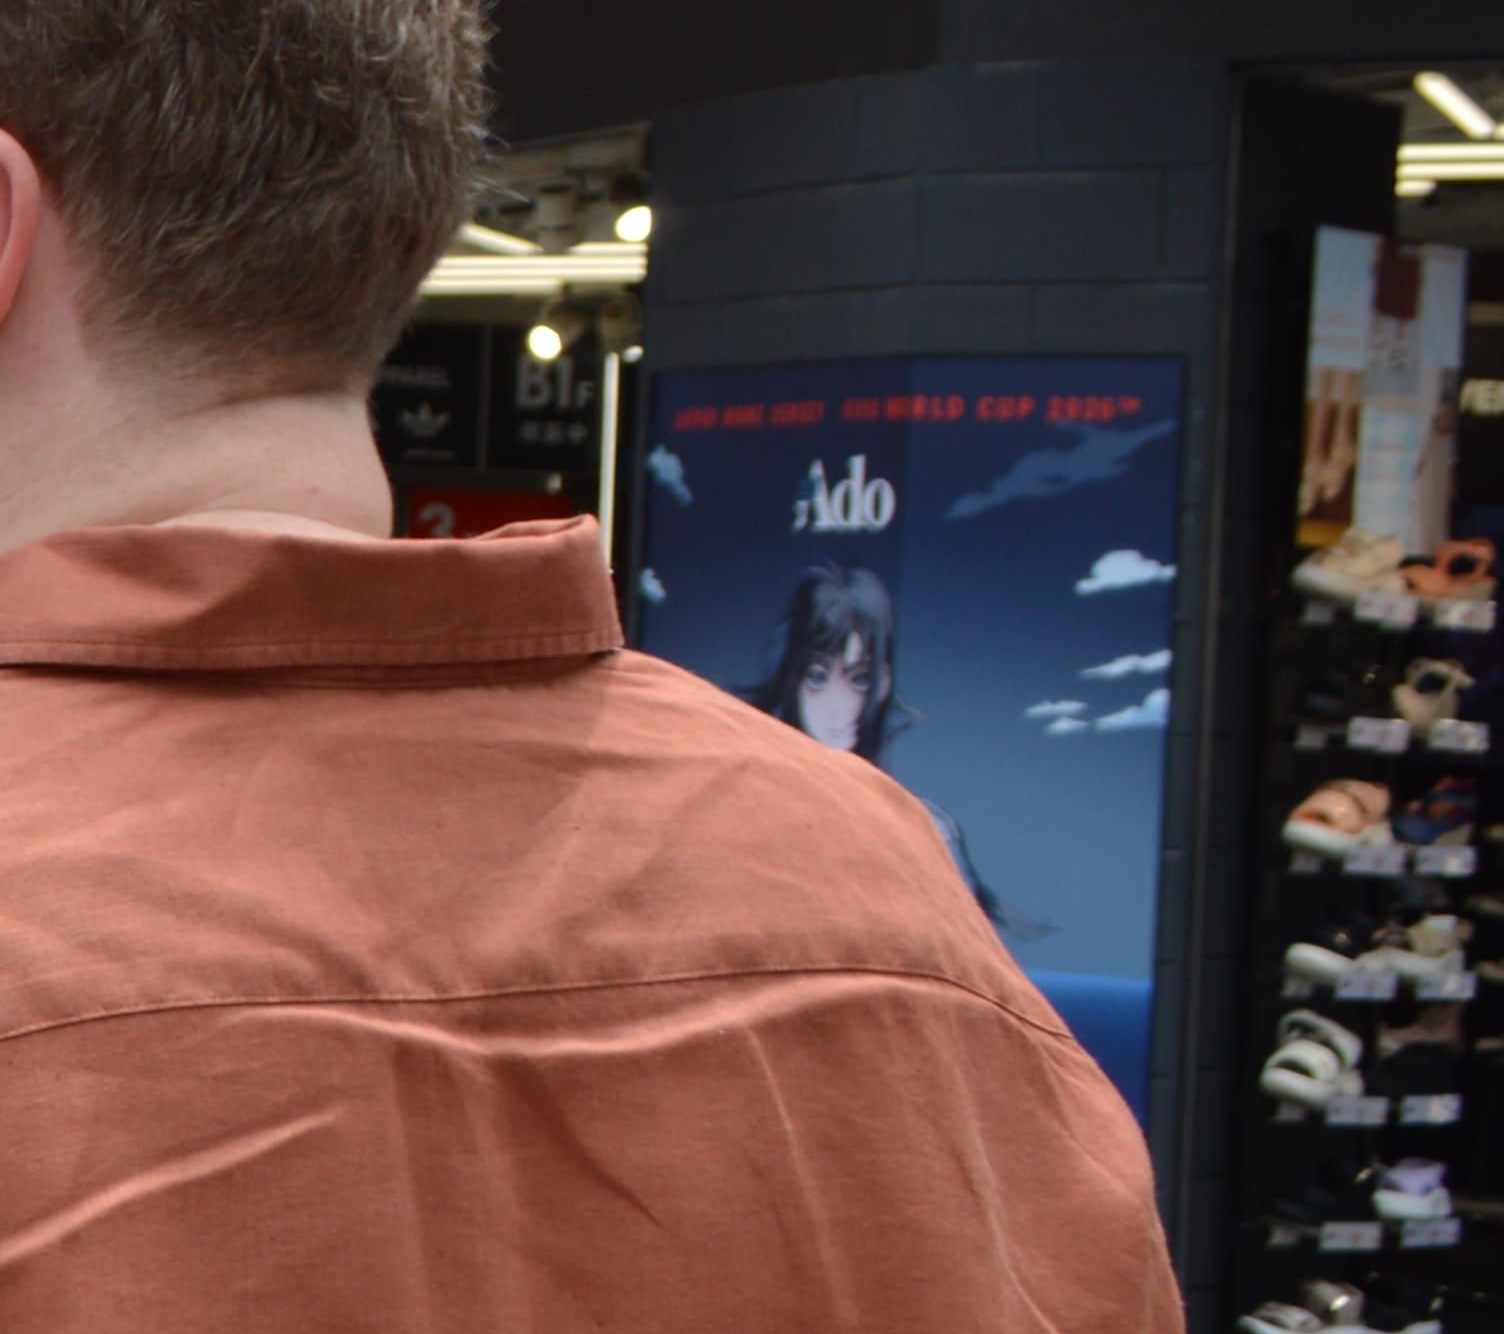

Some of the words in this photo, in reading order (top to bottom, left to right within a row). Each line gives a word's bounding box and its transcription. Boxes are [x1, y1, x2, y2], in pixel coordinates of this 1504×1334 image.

[883, 396, 965, 421] WORLD
[974, 396, 1036, 421] CUP
[793, 454, 896, 534] Ado
